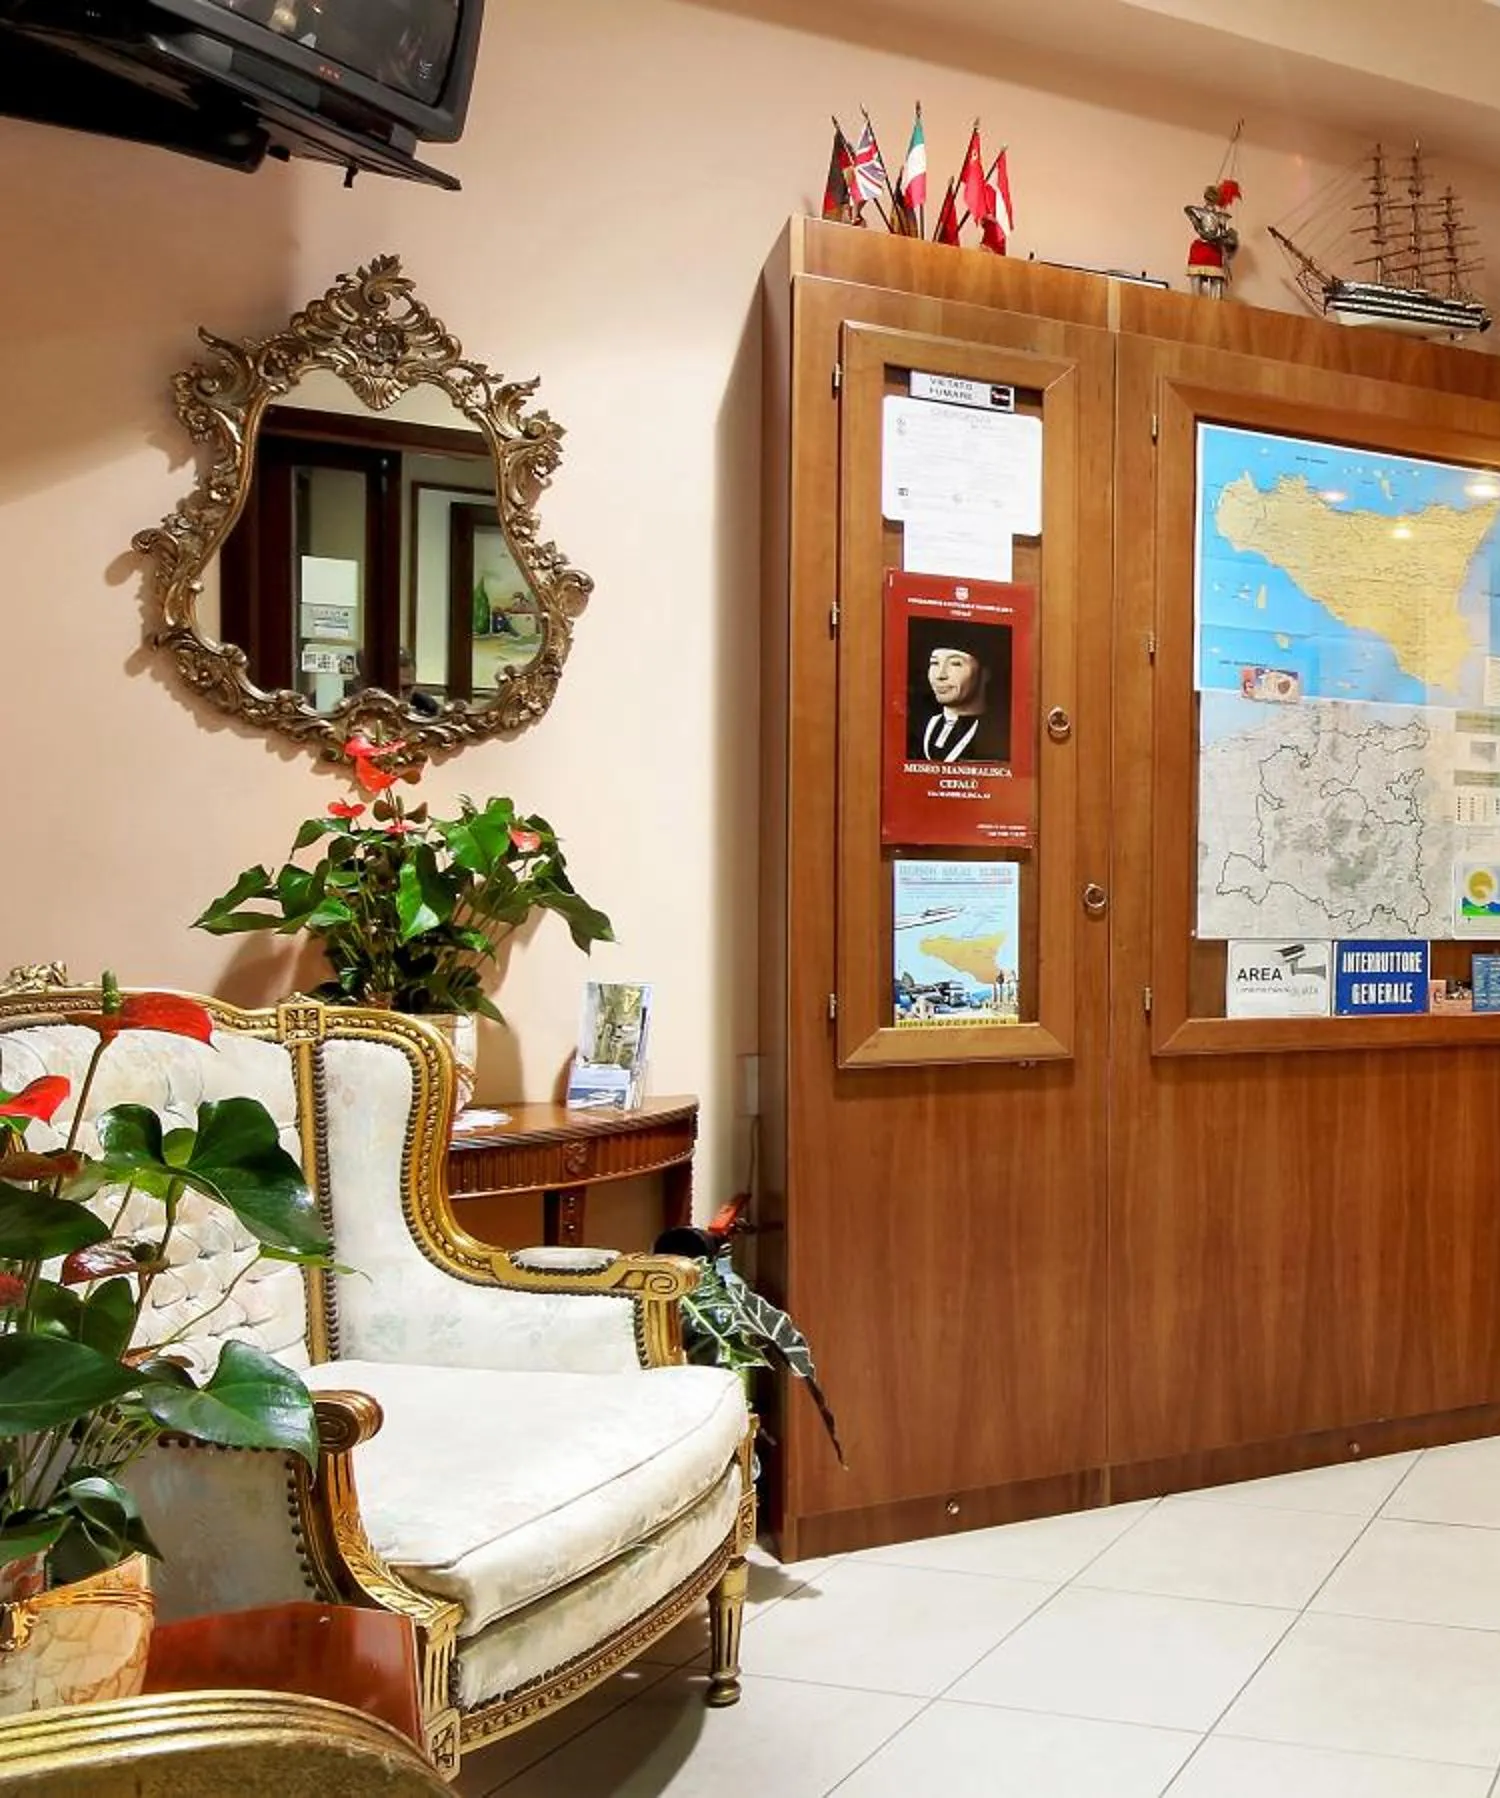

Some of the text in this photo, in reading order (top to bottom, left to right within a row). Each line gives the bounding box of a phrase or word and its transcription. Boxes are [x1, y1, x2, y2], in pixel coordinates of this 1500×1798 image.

[930, 387, 973, 401] FUMARE
[903, 763, 1012, 779] MUSEO MANDRALISCA
[1343, 951, 1423, 973] INTERRUTTORE
[1237, 967, 1283, 981] AREA
[1351, 983, 1413, 1004] GENERALE
